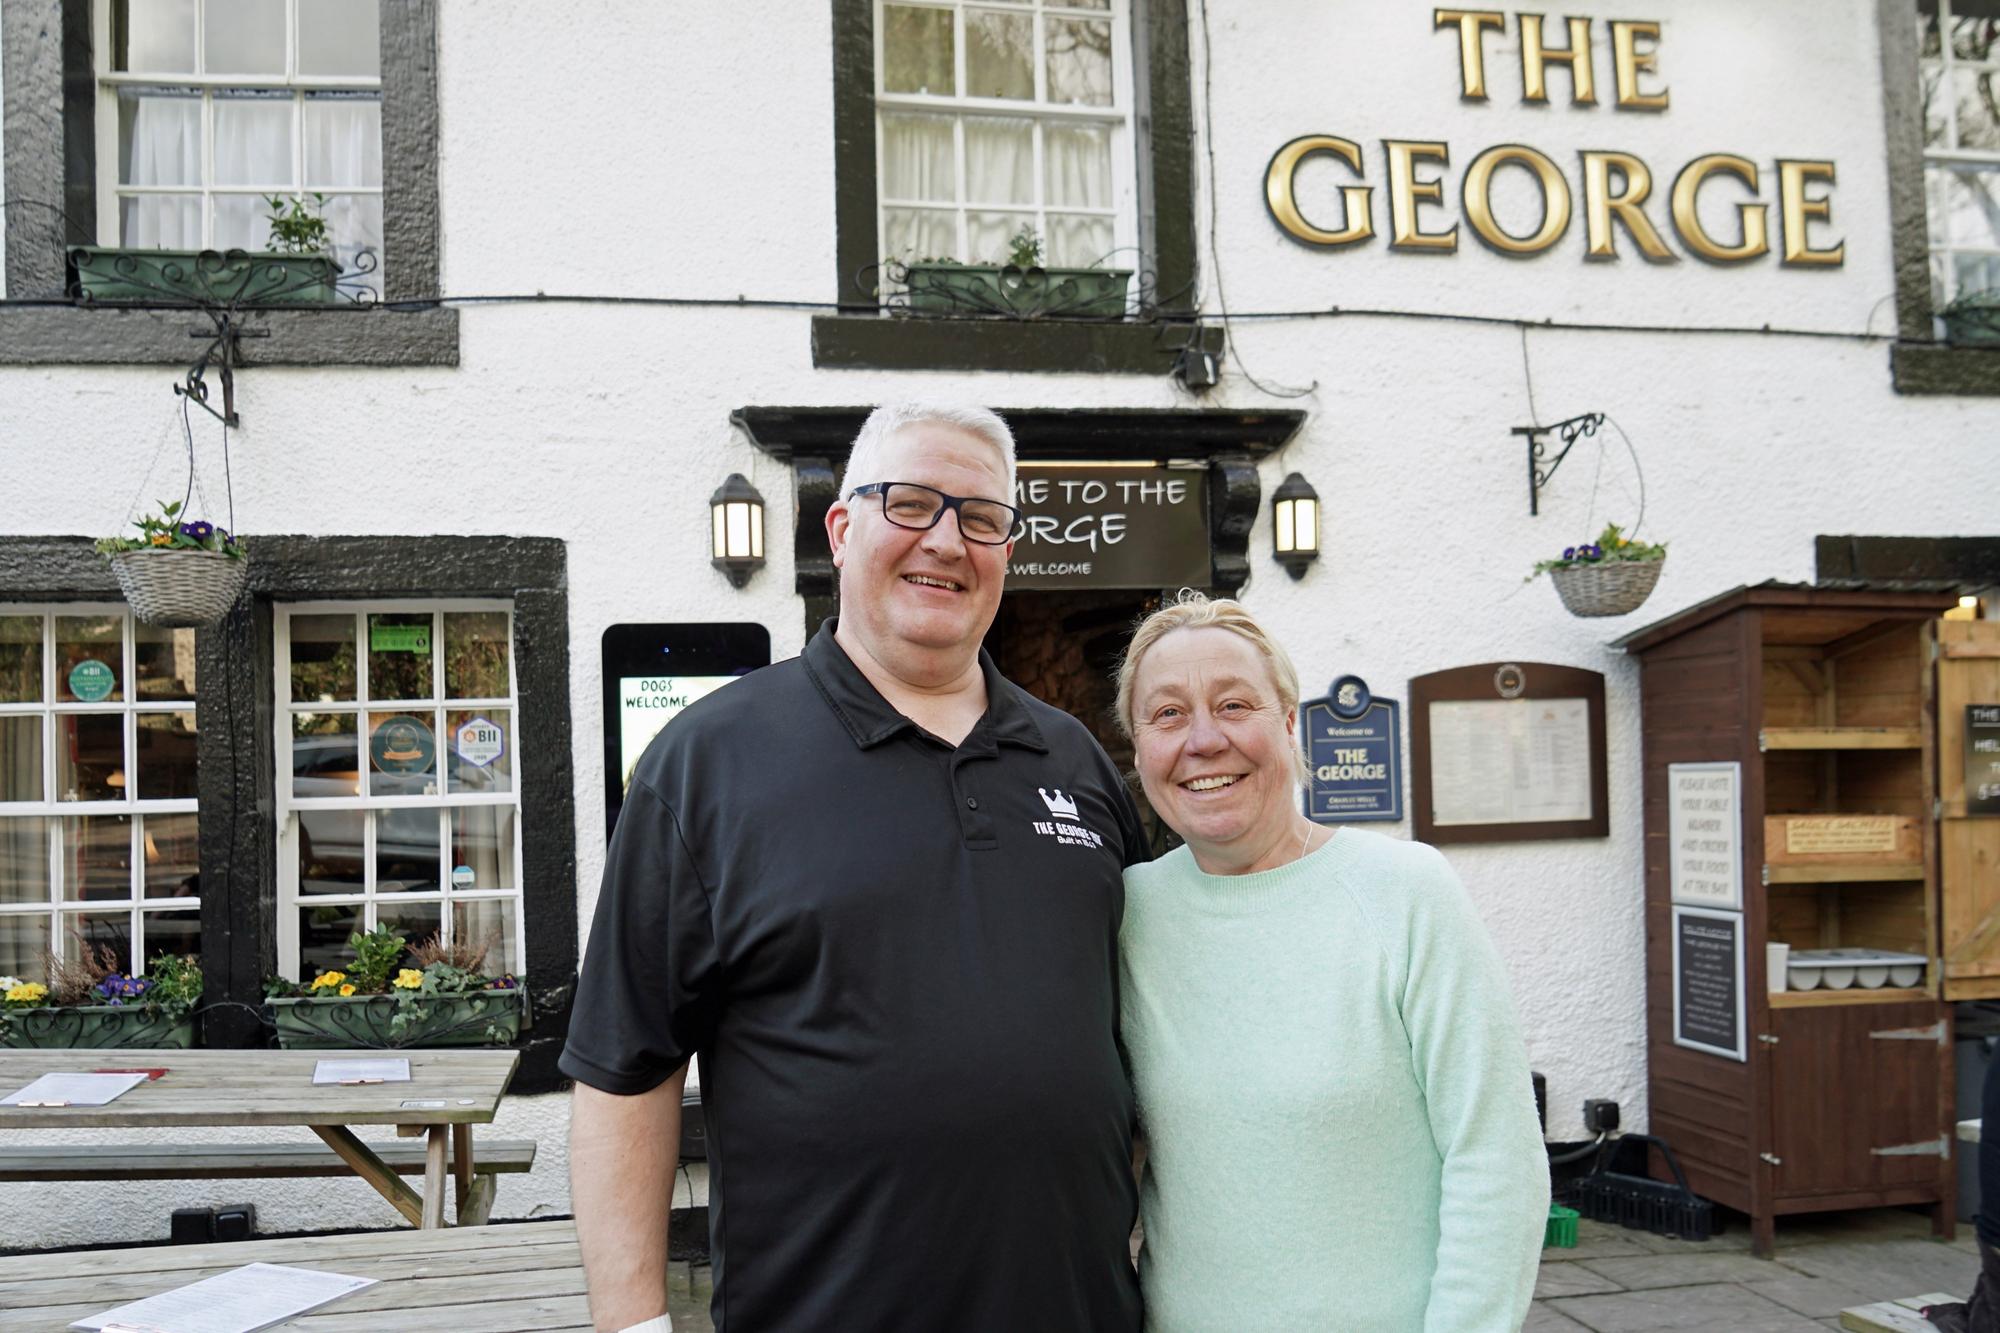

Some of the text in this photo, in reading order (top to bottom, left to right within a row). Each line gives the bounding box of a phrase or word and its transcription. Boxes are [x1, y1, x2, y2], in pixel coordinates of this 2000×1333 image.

[1434, 7, 1669, 111] THE
[1264, 133, 1844, 269] GEORGE
[1058, 480, 1108, 504] TO
[1116, 479, 1187, 505] THE
[1013, 562, 1092, 575] WELCOME
[641, 679, 672, 692] DOGS
[626, 696, 688, 708] WELCOME
[478, 729, 496, 742] BII
[1327, 727, 1374, 736] Welcome to
[1974, 739, 2000, 753] HEL
[1334, 748, 1368, 765] THE
[1317, 764, 1387, 781] GEORGE
[1032, 821, 1055, 835] THE
[1055, 822, 1092, 840] GEORGE
[1687, 818, 1722, 833] NUMBER
